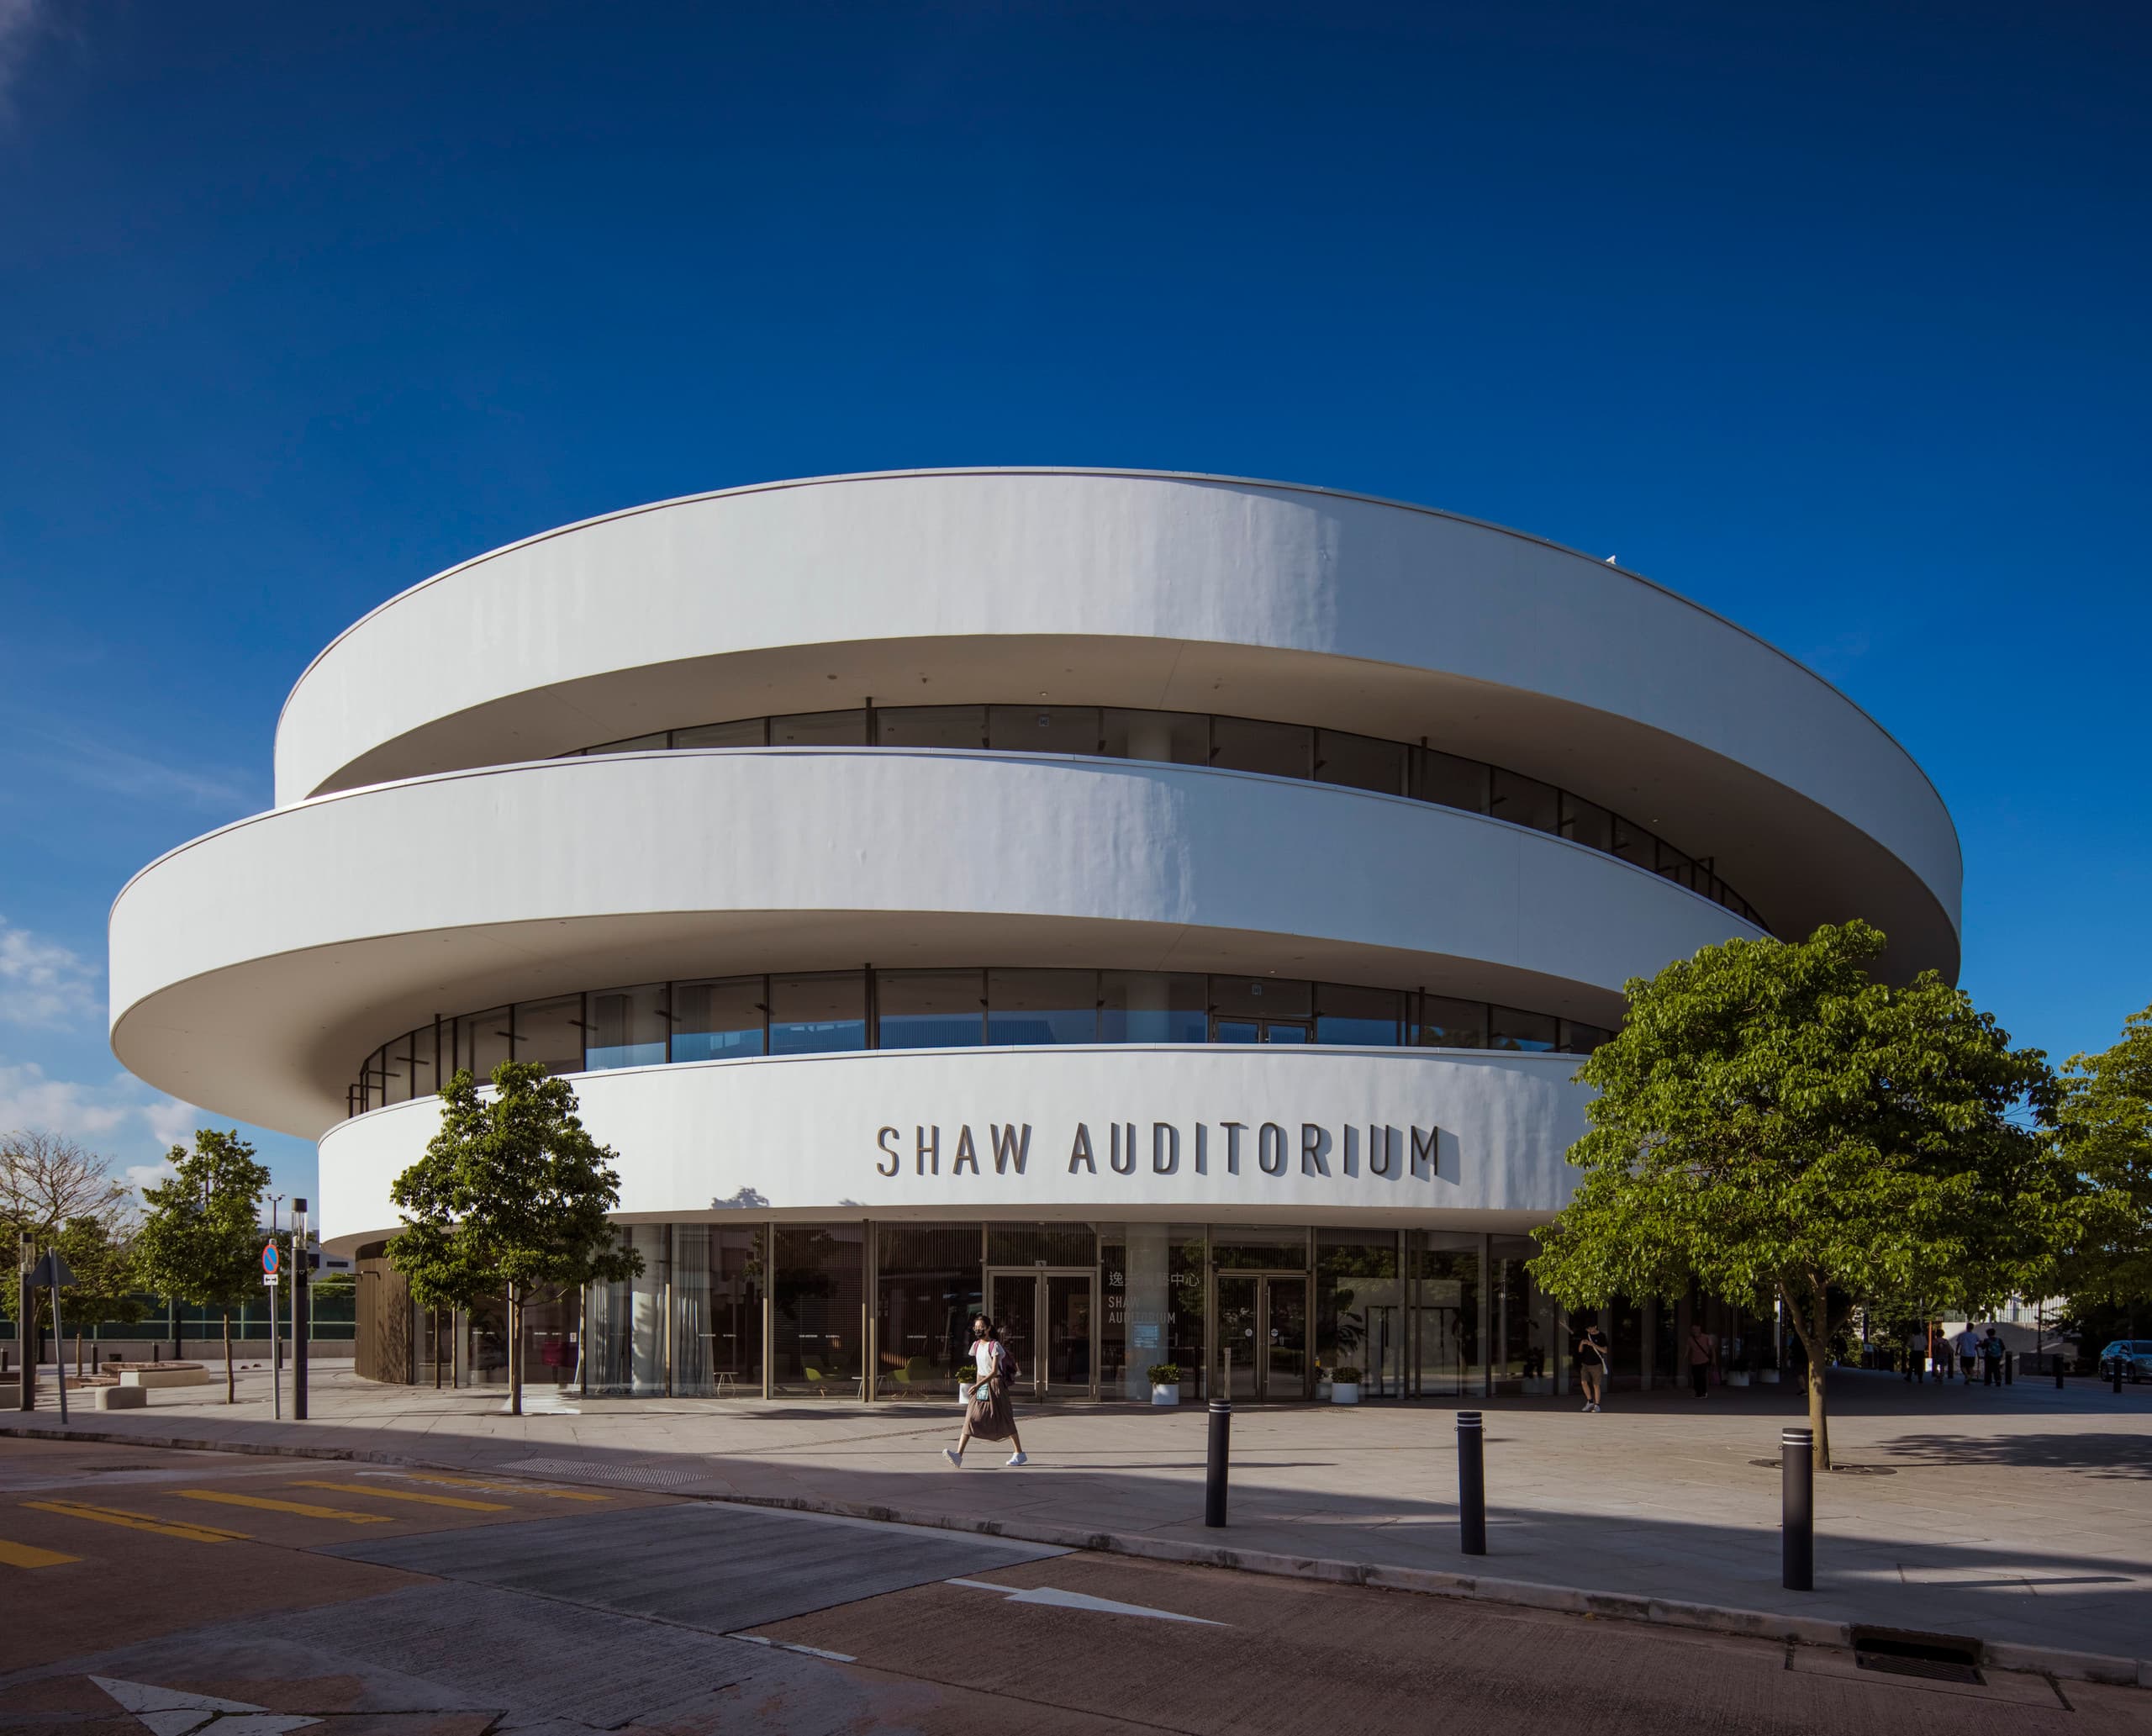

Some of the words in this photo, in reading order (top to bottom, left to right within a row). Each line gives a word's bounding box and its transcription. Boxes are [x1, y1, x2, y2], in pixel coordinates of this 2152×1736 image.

[877, 1122, 1030, 1176] SHAW
[1068, 1121, 1439, 1177] AUDITORIUM
[1108, 1295, 1139, 1308] SHAW
